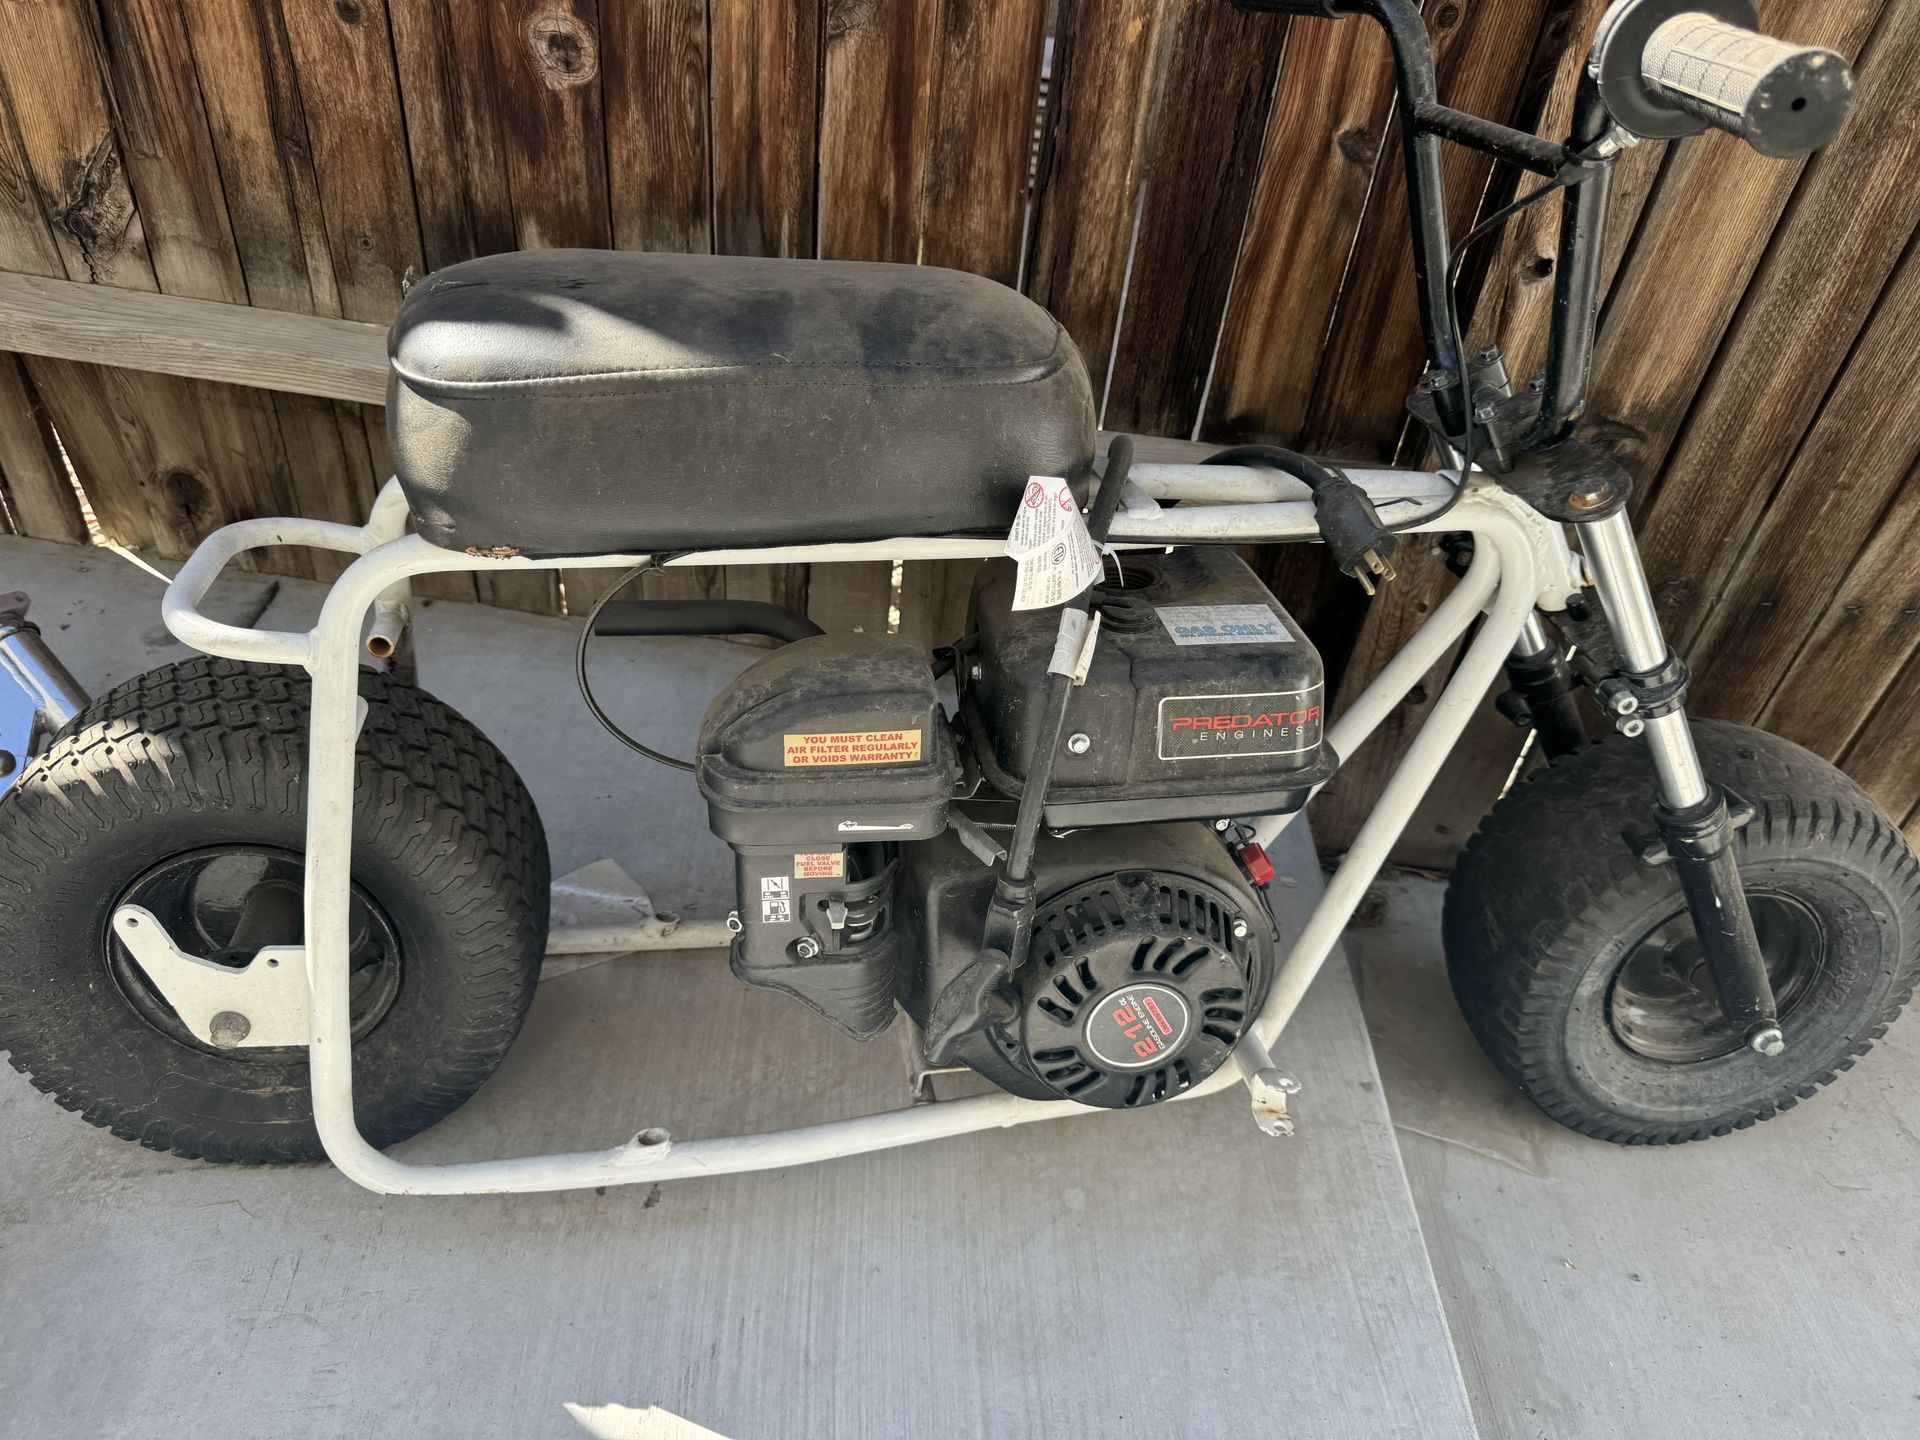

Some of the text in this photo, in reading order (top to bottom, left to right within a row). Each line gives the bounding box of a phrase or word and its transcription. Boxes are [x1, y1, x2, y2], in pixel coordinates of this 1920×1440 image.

[1221, 623, 1278, 636] ONLY
[1172, 706, 1320, 731] PREDATOR
[830, 735, 863, 743] MUST
[866, 733, 903, 742] CLEAN
[1200, 725, 1304, 741] ENGINES
[787, 742, 919, 754] AIR FILTER REGULARLY
[812, 754, 847, 763] VOIDS
[850, 752, 913, 762] WARRANTY
[1126, 994, 1166, 1050] GASOLINE ENGINE
[1112, 1005, 1158, 1058] 212
